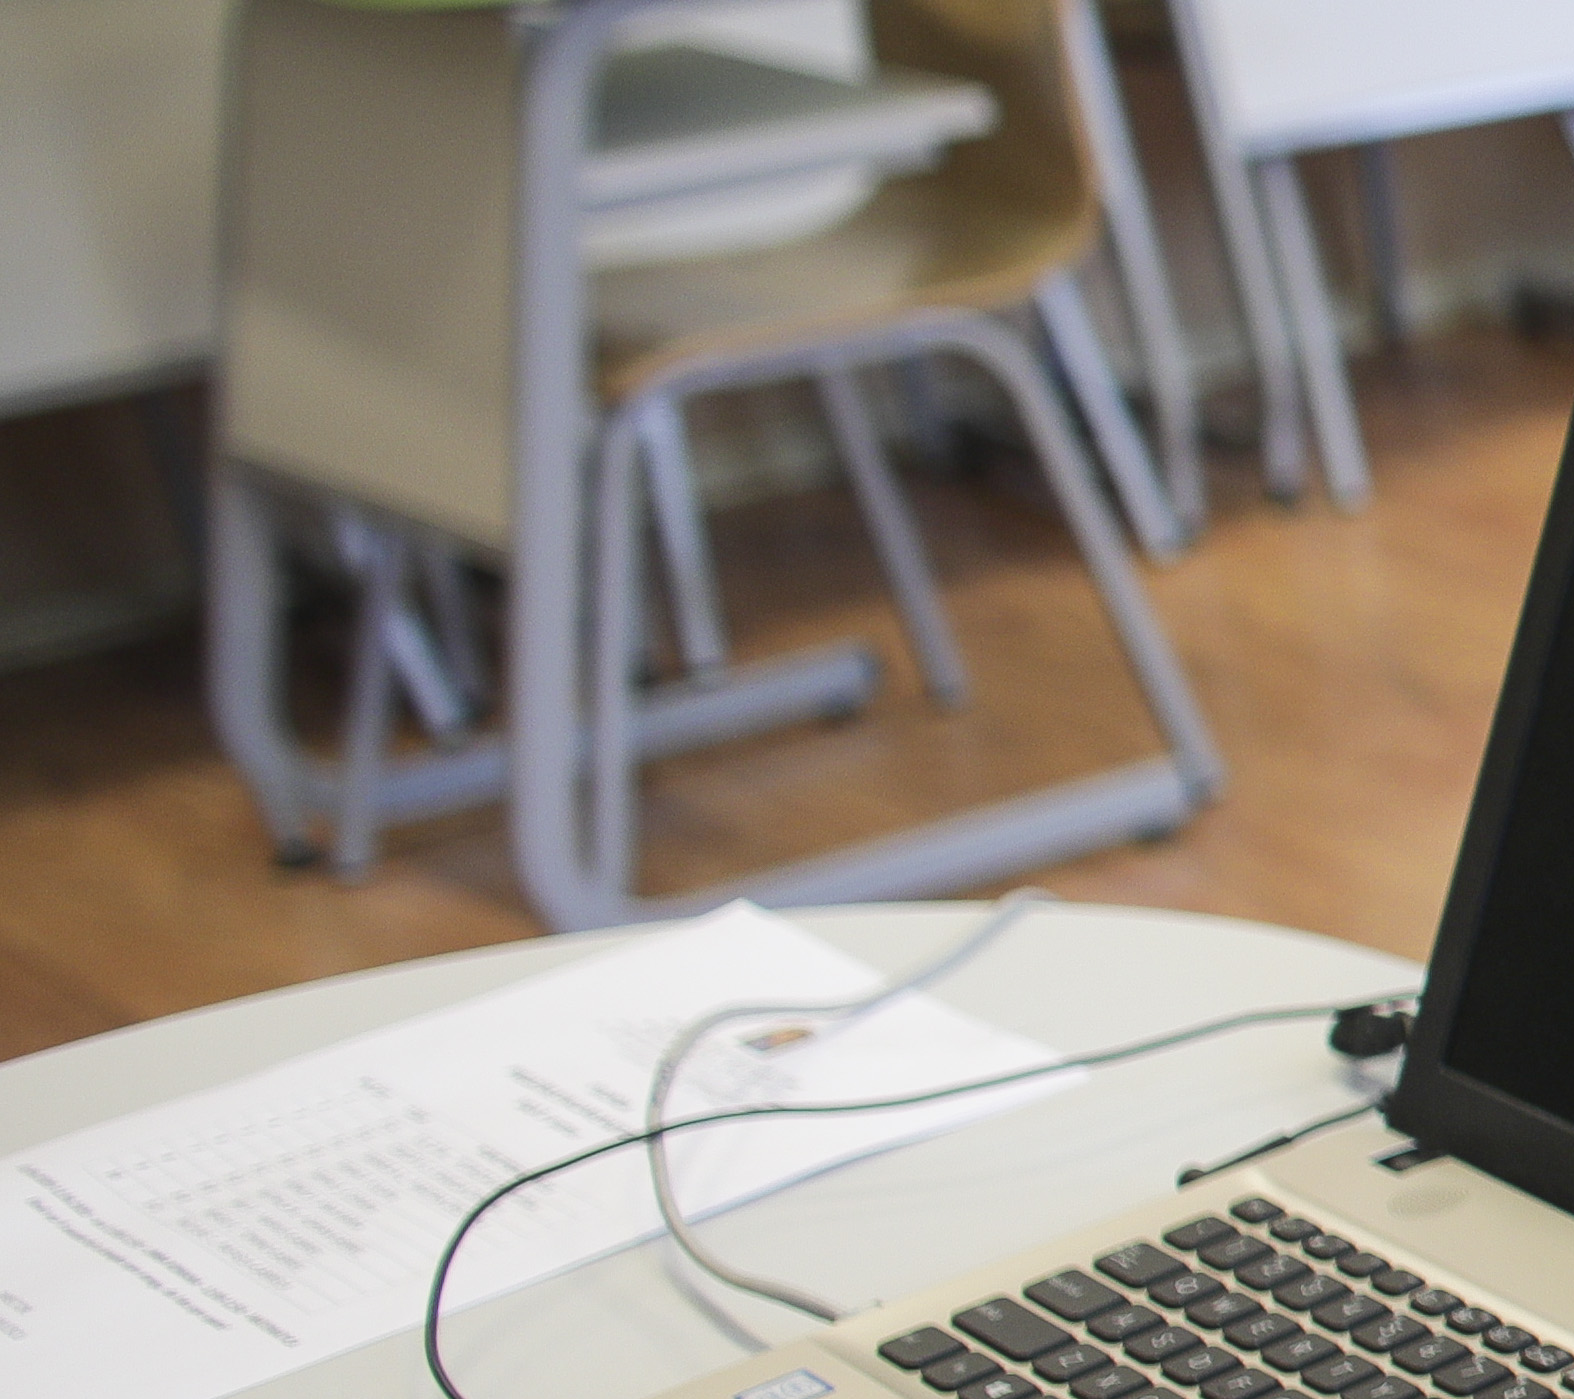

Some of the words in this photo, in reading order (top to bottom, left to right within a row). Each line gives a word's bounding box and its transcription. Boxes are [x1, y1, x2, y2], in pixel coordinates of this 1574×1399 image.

[1174, 1276, 1199, 1294] Q
[1250, 1319, 1274, 1335] E
[1151, 1332, 1175, 1348] S
[1187, 1352, 1212, 1369] D
